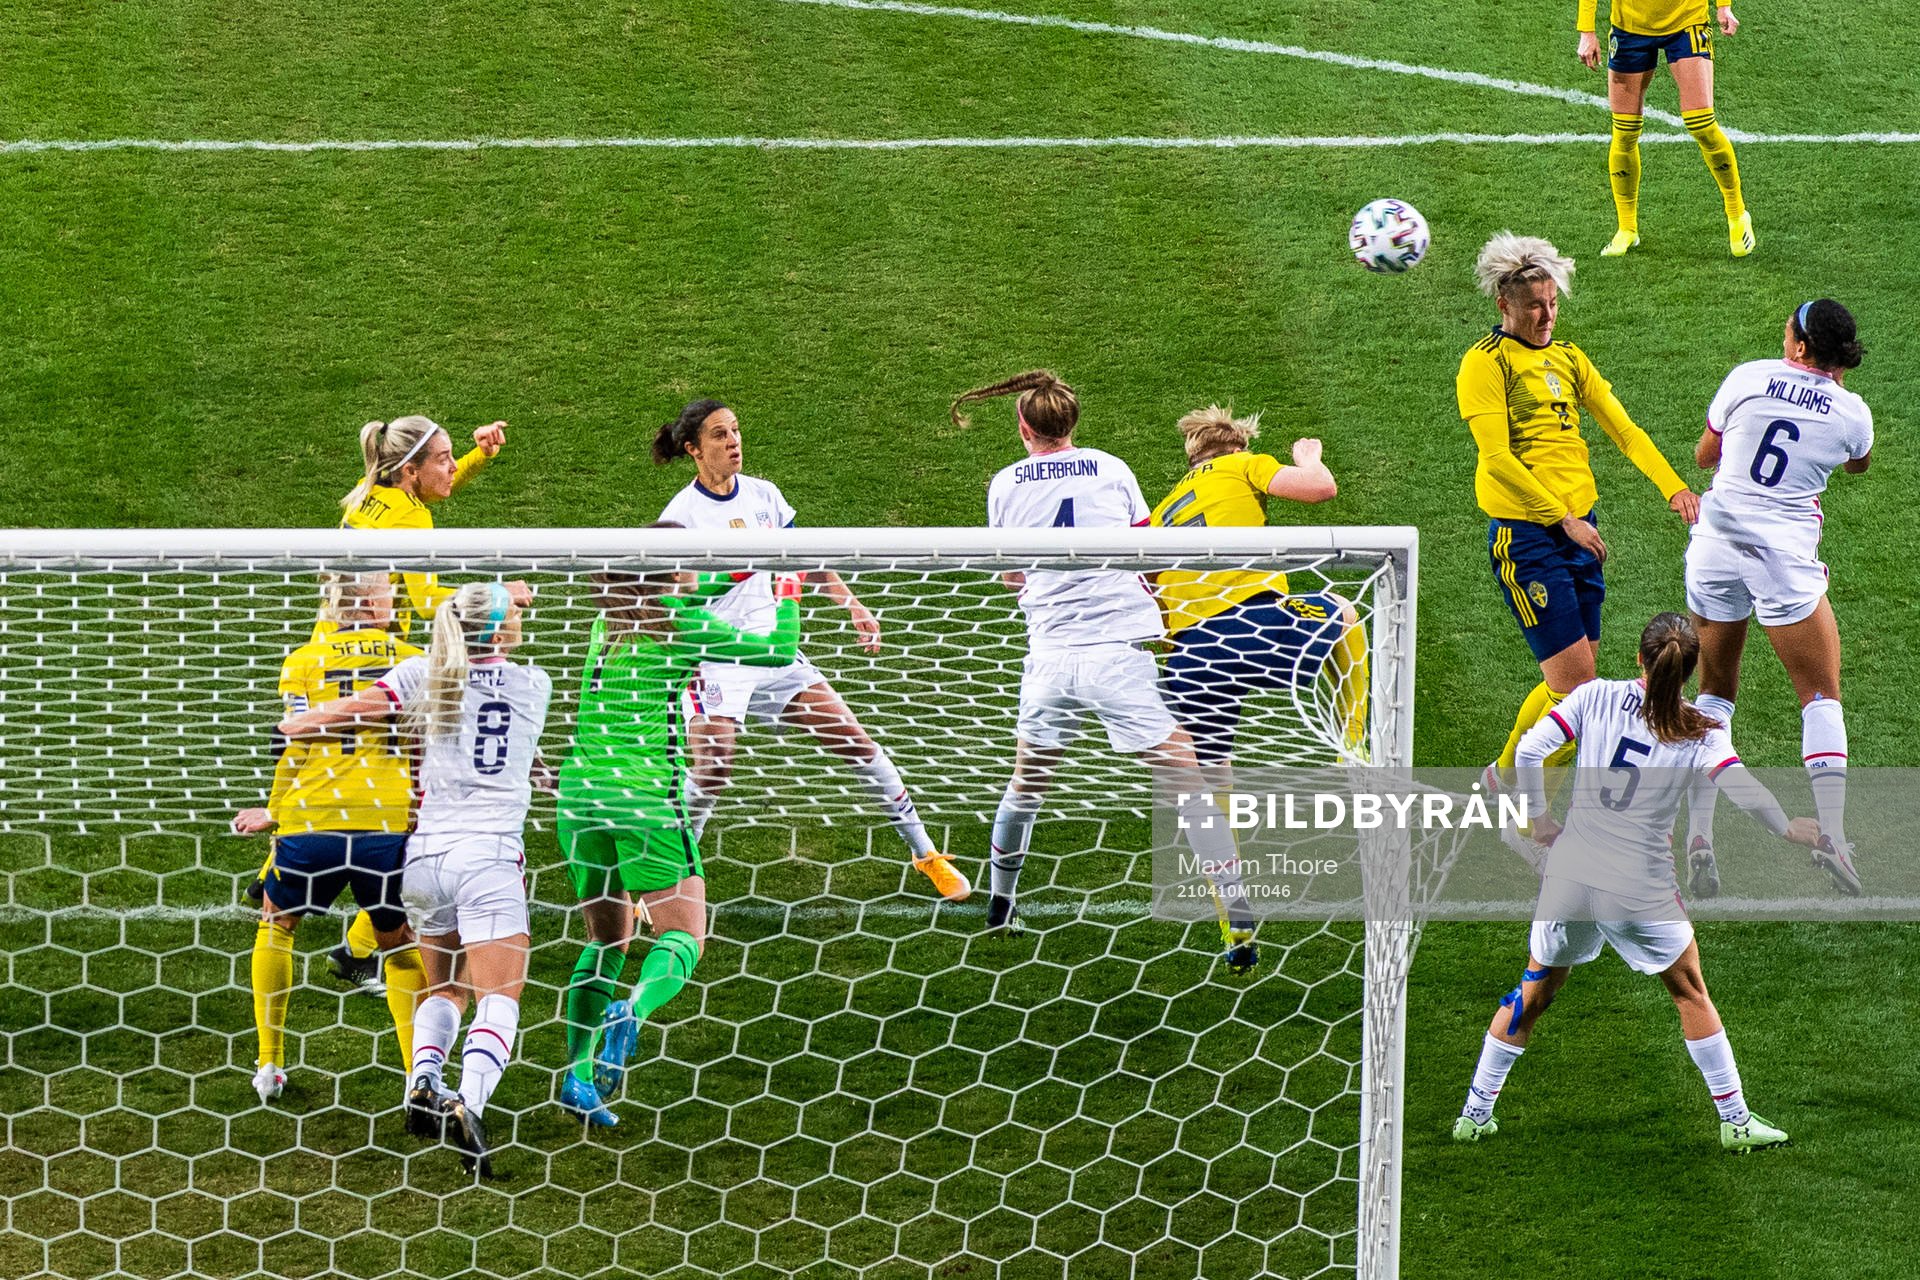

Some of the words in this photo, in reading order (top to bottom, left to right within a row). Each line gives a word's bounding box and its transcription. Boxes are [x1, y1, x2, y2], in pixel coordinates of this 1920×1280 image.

[1765, 377, 1833, 415] WILLIAMS
[1014, 459, 1098, 484] SAUERBRUNN
[1750, 419, 1800, 488] 6
[473, 701, 511, 775] 8
[1600, 735, 1652, 812] 5
